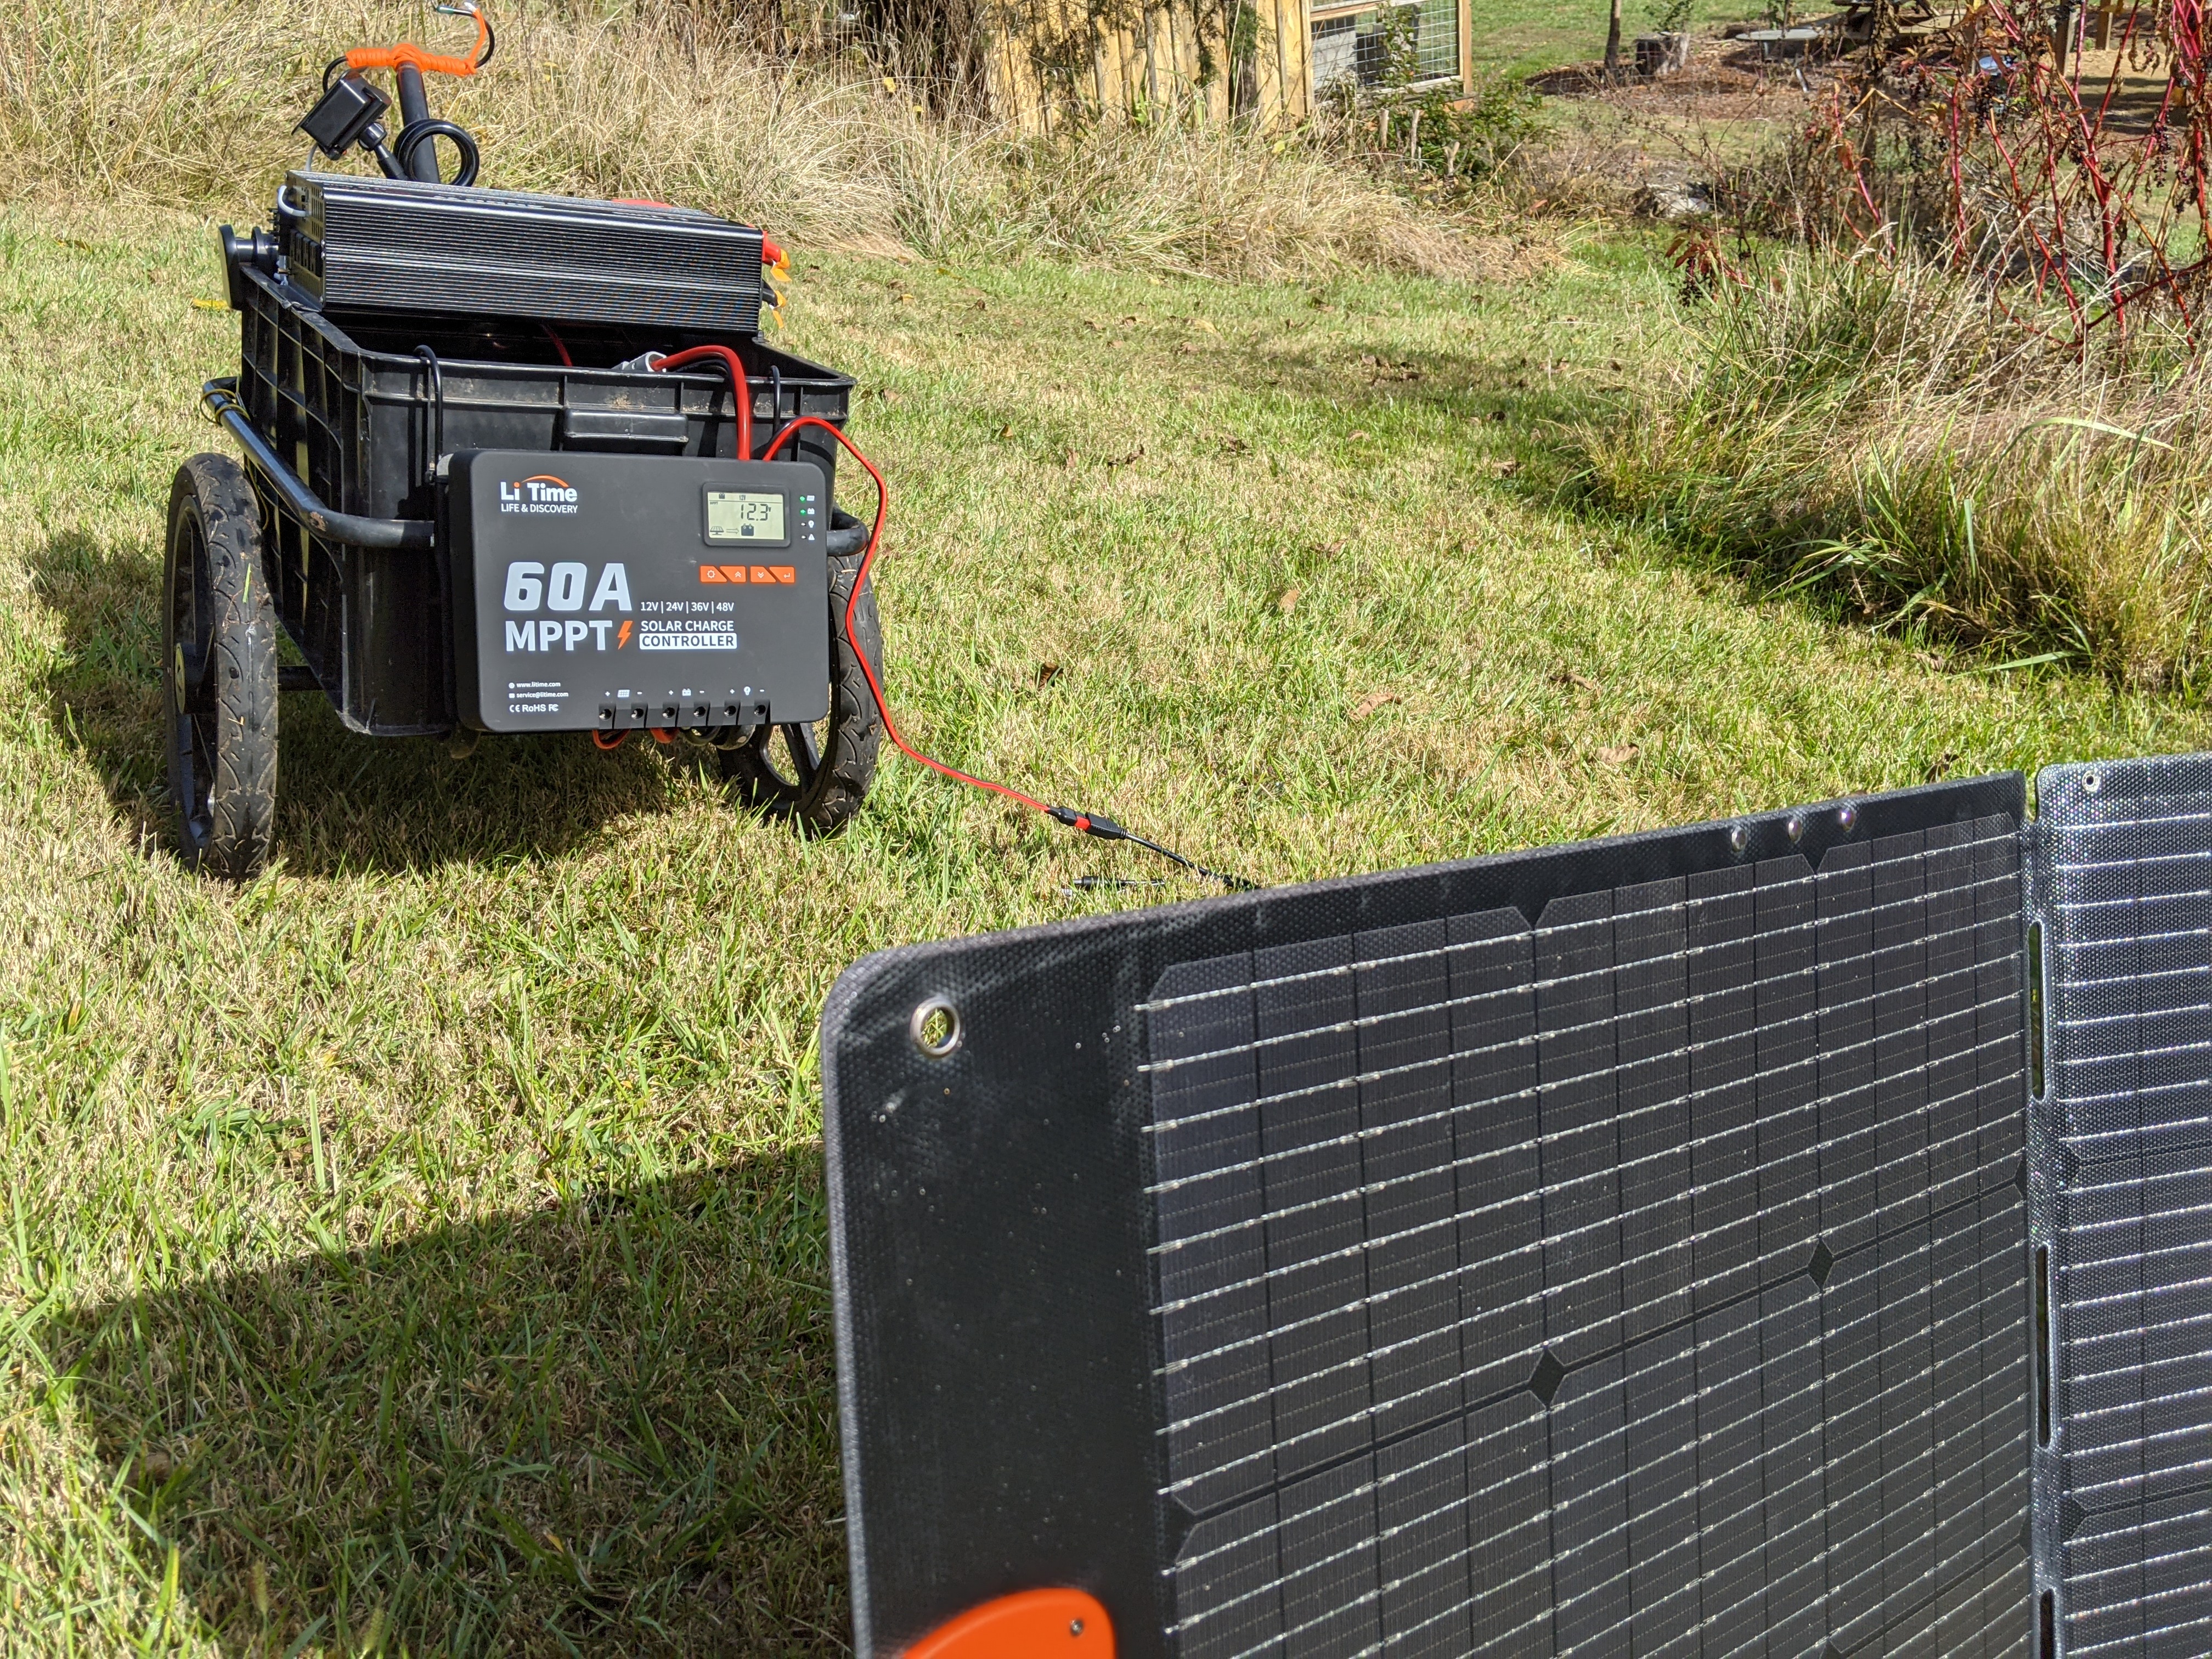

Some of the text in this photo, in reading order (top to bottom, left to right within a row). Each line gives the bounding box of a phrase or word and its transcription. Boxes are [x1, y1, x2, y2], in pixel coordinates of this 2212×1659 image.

[500, 481, 578, 502] Li Time
[501, 503, 578, 513] LIFE & DISCOVERY
[504, 562, 633, 611] 60A
[640, 602, 659, 611] 12V
[666, 602, 684, 611] 24V
[691, 602, 709, 611] 36V
[716, 602, 735, 611] 48V
[641, 620, 735, 631] SOLAR CHARGE
[505, 620, 613, 651] MPPT
[642, 635, 735, 647] CONTROLLER
[522, 704, 546, 712] RoHS
